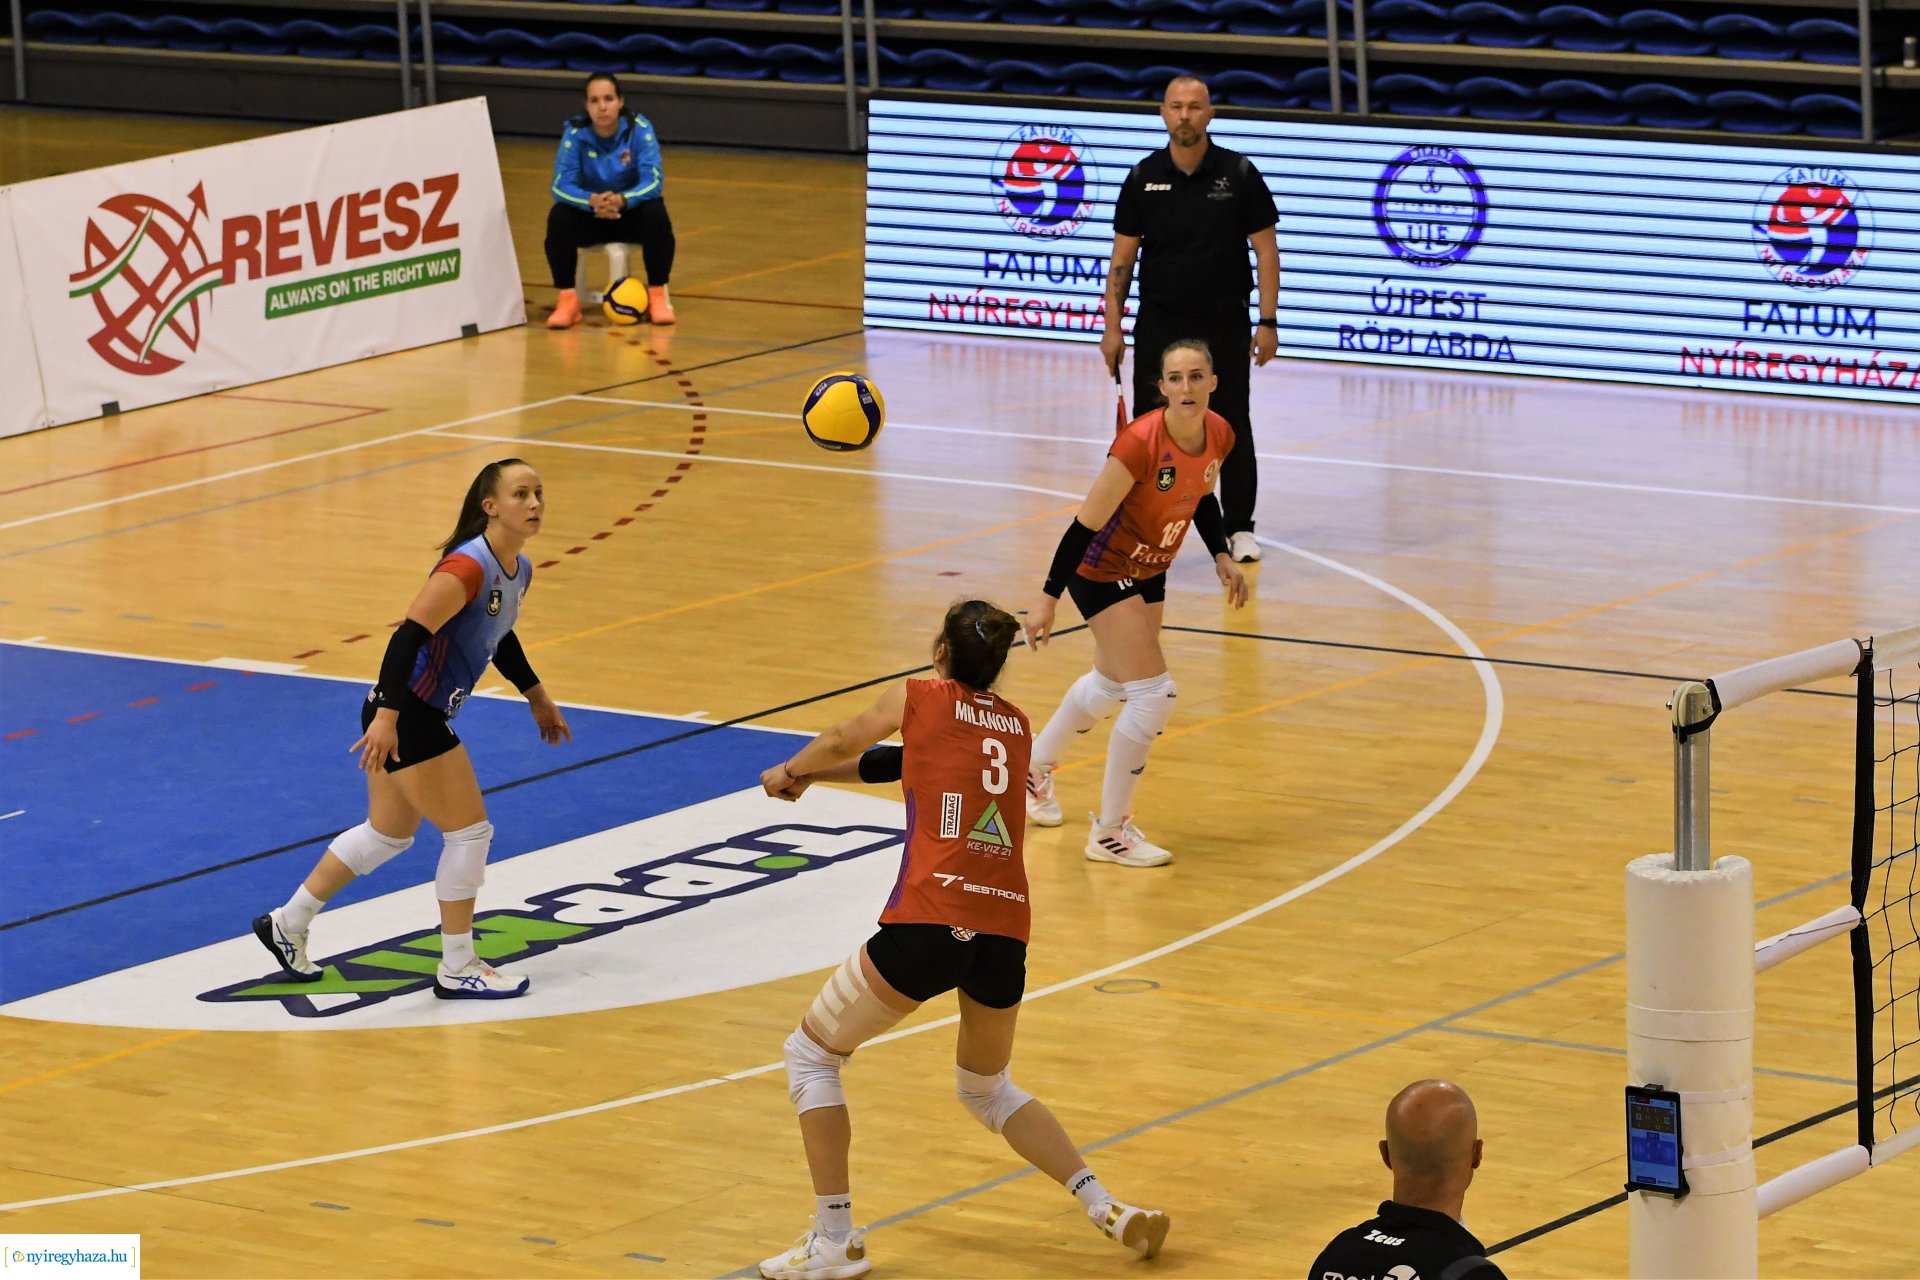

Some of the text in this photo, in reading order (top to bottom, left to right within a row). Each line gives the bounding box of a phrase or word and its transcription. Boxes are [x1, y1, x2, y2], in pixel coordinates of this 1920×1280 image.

[269, 256, 457, 312] ALWAYS ON THE RIGHT WAY
[983, 250, 1101, 287] FATUM
[1371, 276, 1487, 320] ÚJPEST
[1743, 300, 1877, 340] FATUM
[1338, 320, 1517, 362] RÖPLABDA
[1158, 519, 1186, 549] 18
[955, 700, 1024, 736] MILANOVA
[981, 738, 1009, 795] 3
[946, 795, 957, 837] STRABAG
[966, 840, 1001, 855] KE-VIZ
[1000, 847, 1012, 857] 21
[963, 883, 1026, 903] BESTRONG
[1363, 1229, 1407, 1247] Zeus
